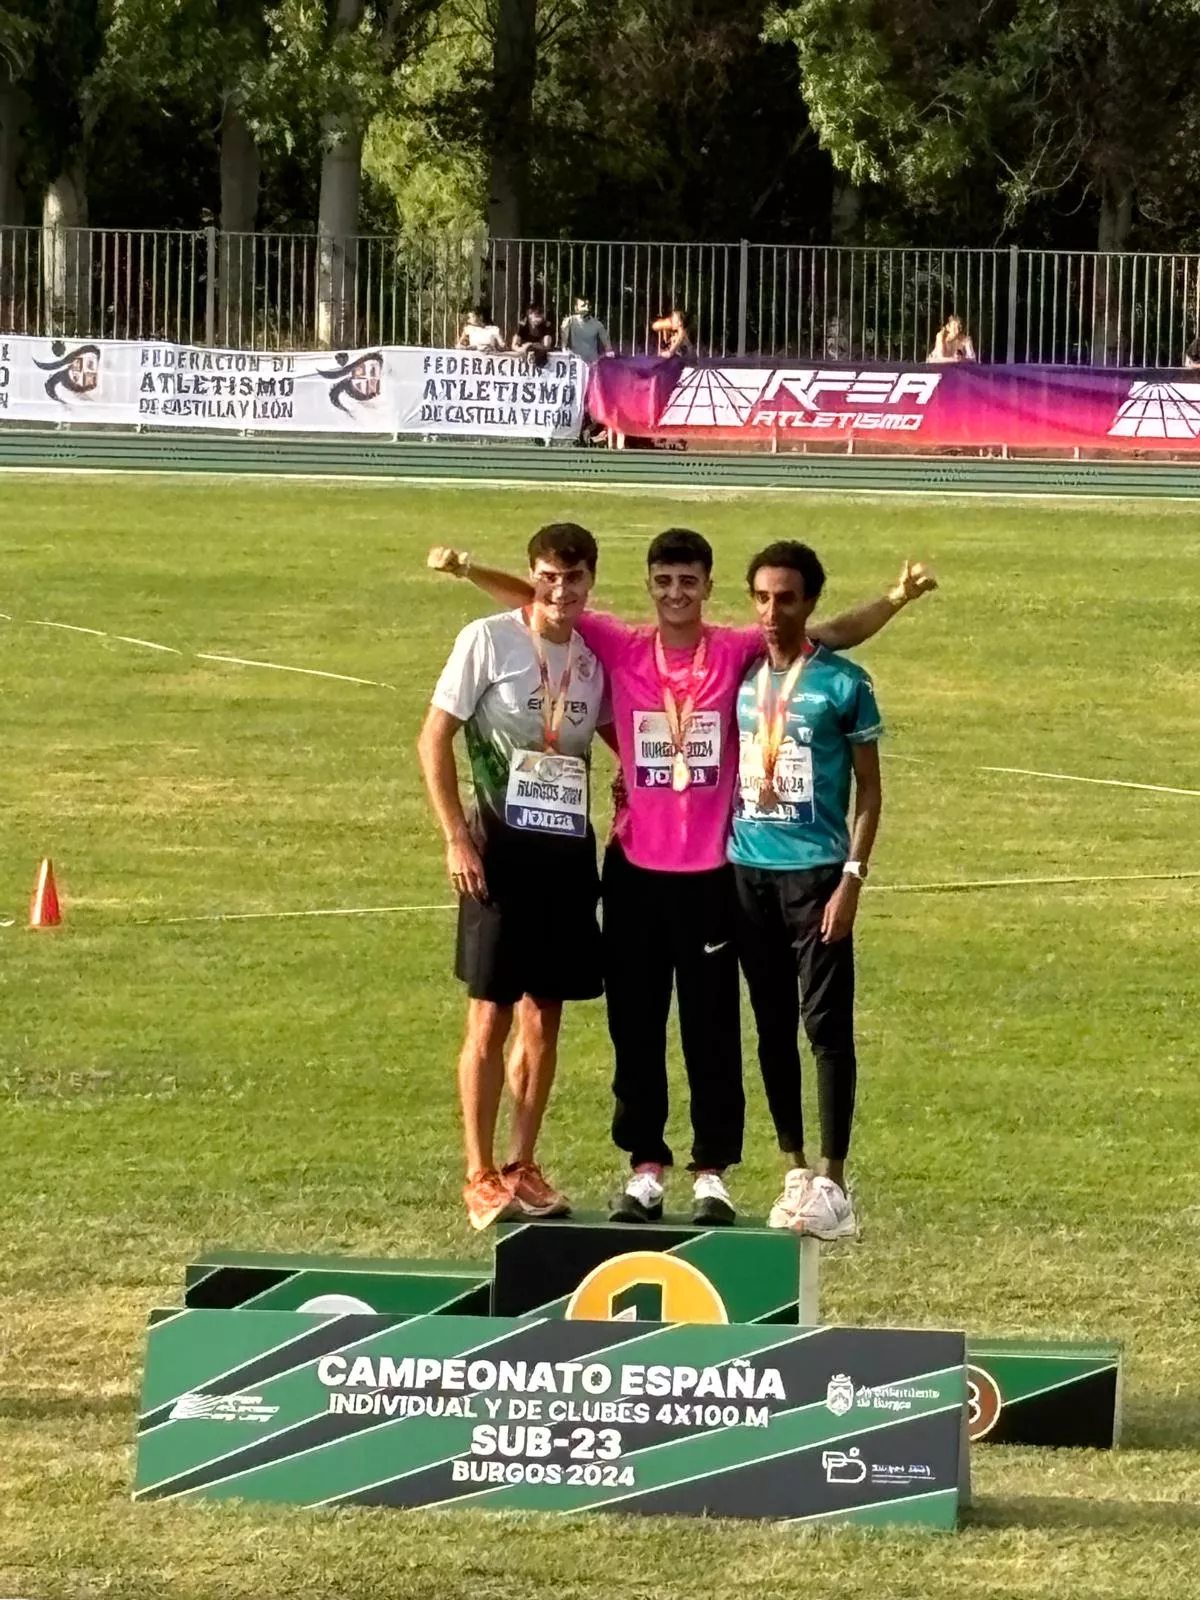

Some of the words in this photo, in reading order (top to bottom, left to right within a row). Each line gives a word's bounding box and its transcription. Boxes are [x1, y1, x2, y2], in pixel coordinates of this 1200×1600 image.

[140, 372, 294, 396] ATLETISMO
[423, 378, 576, 406] ATLETISMO
[139, 397, 159, 415] DE
[161, 399, 237, 419] CASTILLA
[238, 400, 249, 418] Y
[421, 404, 442, 422] DE
[445, 405, 517, 425] CASTILLA
[521, 408, 531, 425] Y
[751, 410, 924, 431] ATLETISMO
[317, 1355, 612, 1393] CAMPEONATO
[620, 1358, 787, 1400] ESPAÑA
[328, 1393, 478, 1418] INDIVIDUAL
[485, 1398, 502, 1420] Y
[508, 1399, 542, 1421] DE
[548, 1400, 650, 1424] CLUBES
[655, 1402, 739, 1427] 4X100
[745, 1405, 769, 1429] M
[471, 1424, 622, 1460] SUB-23
[452, 1460, 562, 1485] BURGOS
[567, 1464, 636, 1488] 2024
